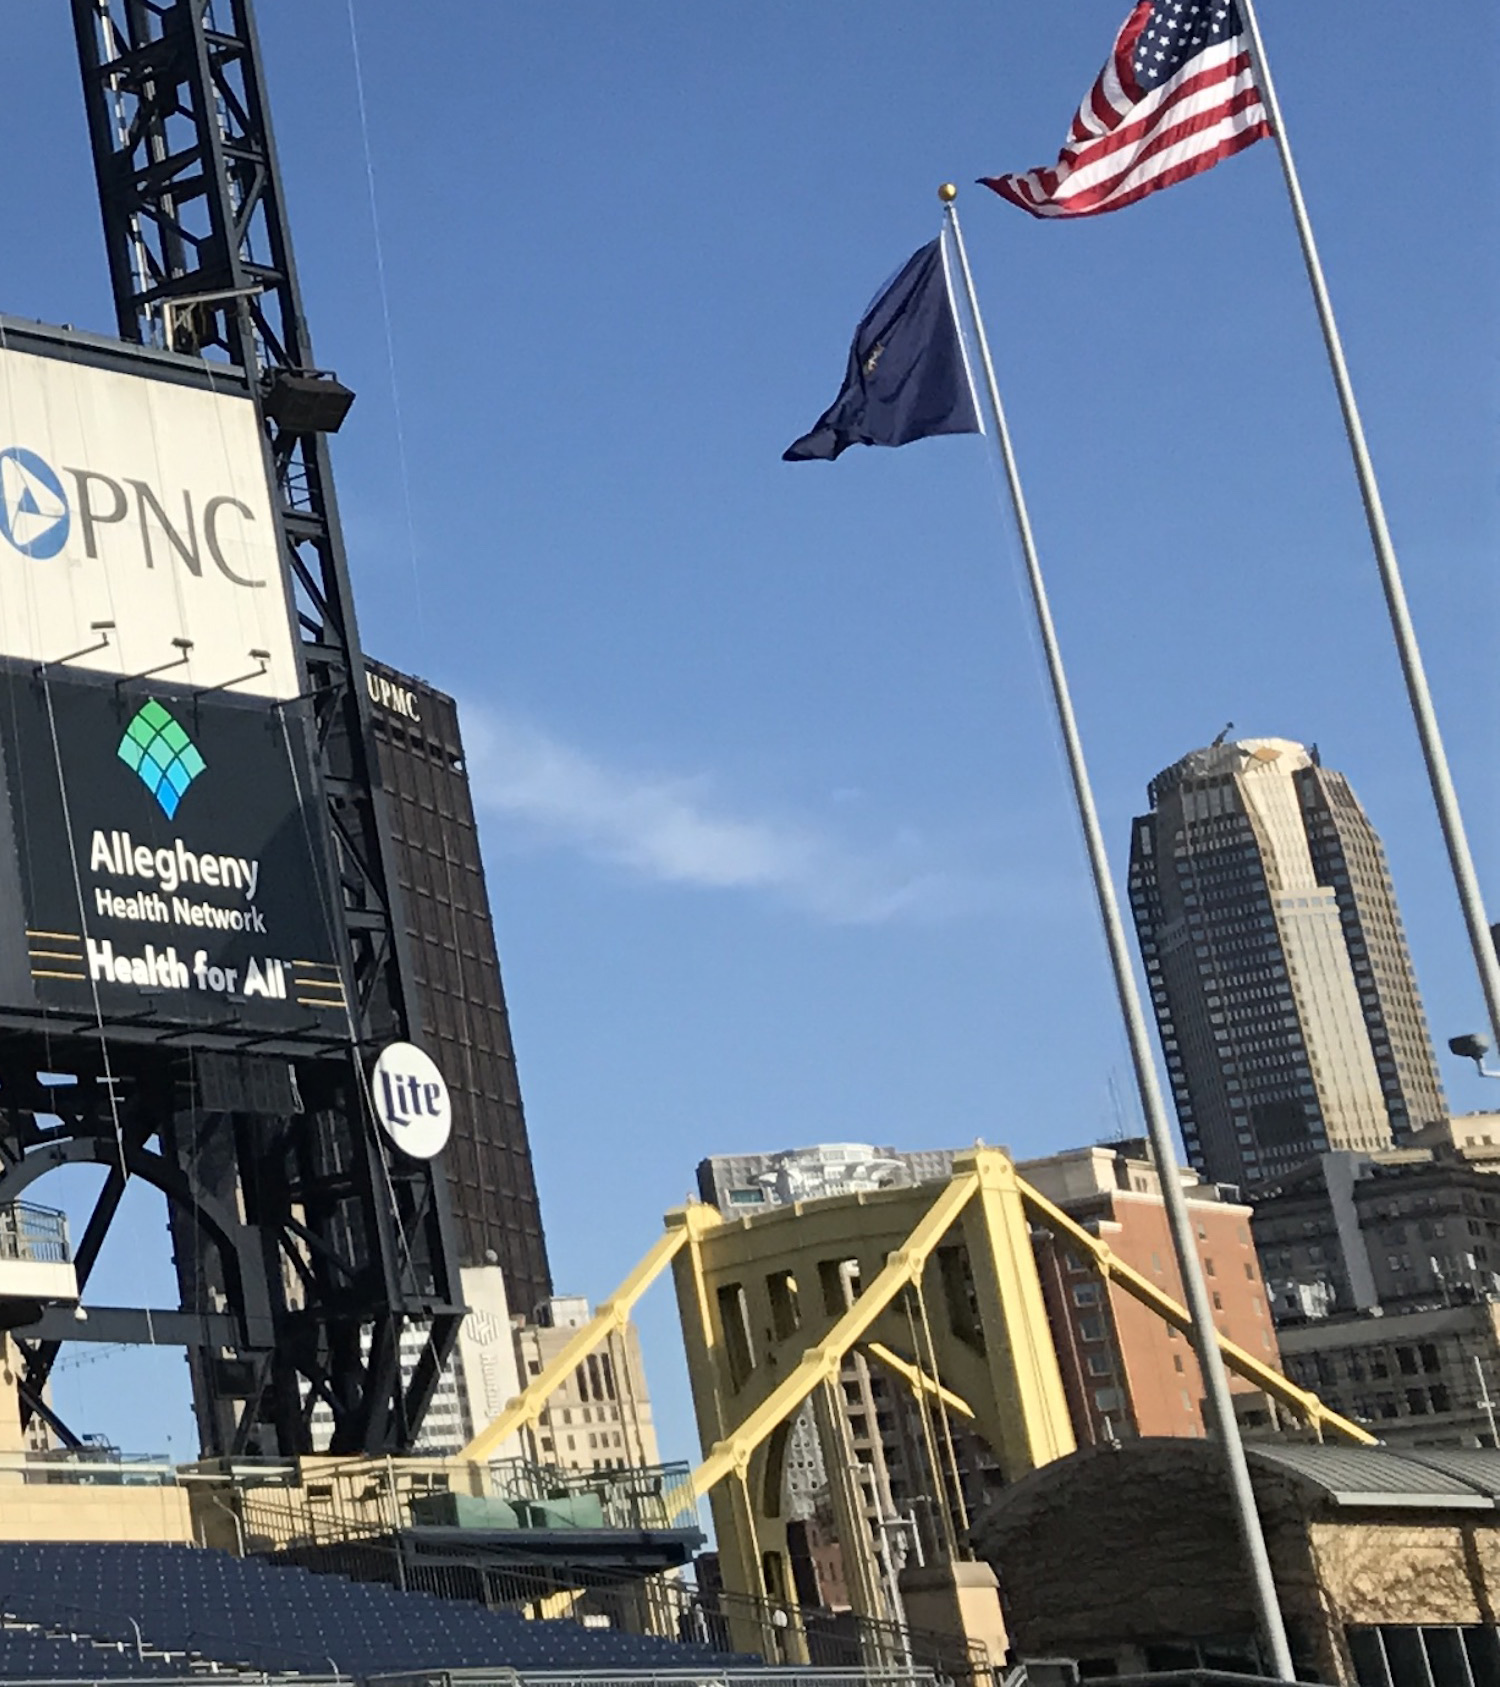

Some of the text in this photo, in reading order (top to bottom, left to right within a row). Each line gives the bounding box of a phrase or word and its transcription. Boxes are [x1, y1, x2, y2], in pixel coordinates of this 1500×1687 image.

[62, 465, 267, 588] PNC
[364, 670, 422, 723] UPMC
[90, 830, 259, 900] Allegheny
[95, 888, 267, 934] Health Network
[86, 938, 288, 1000] Health for All
[380, 1070, 442, 1127] Lite
